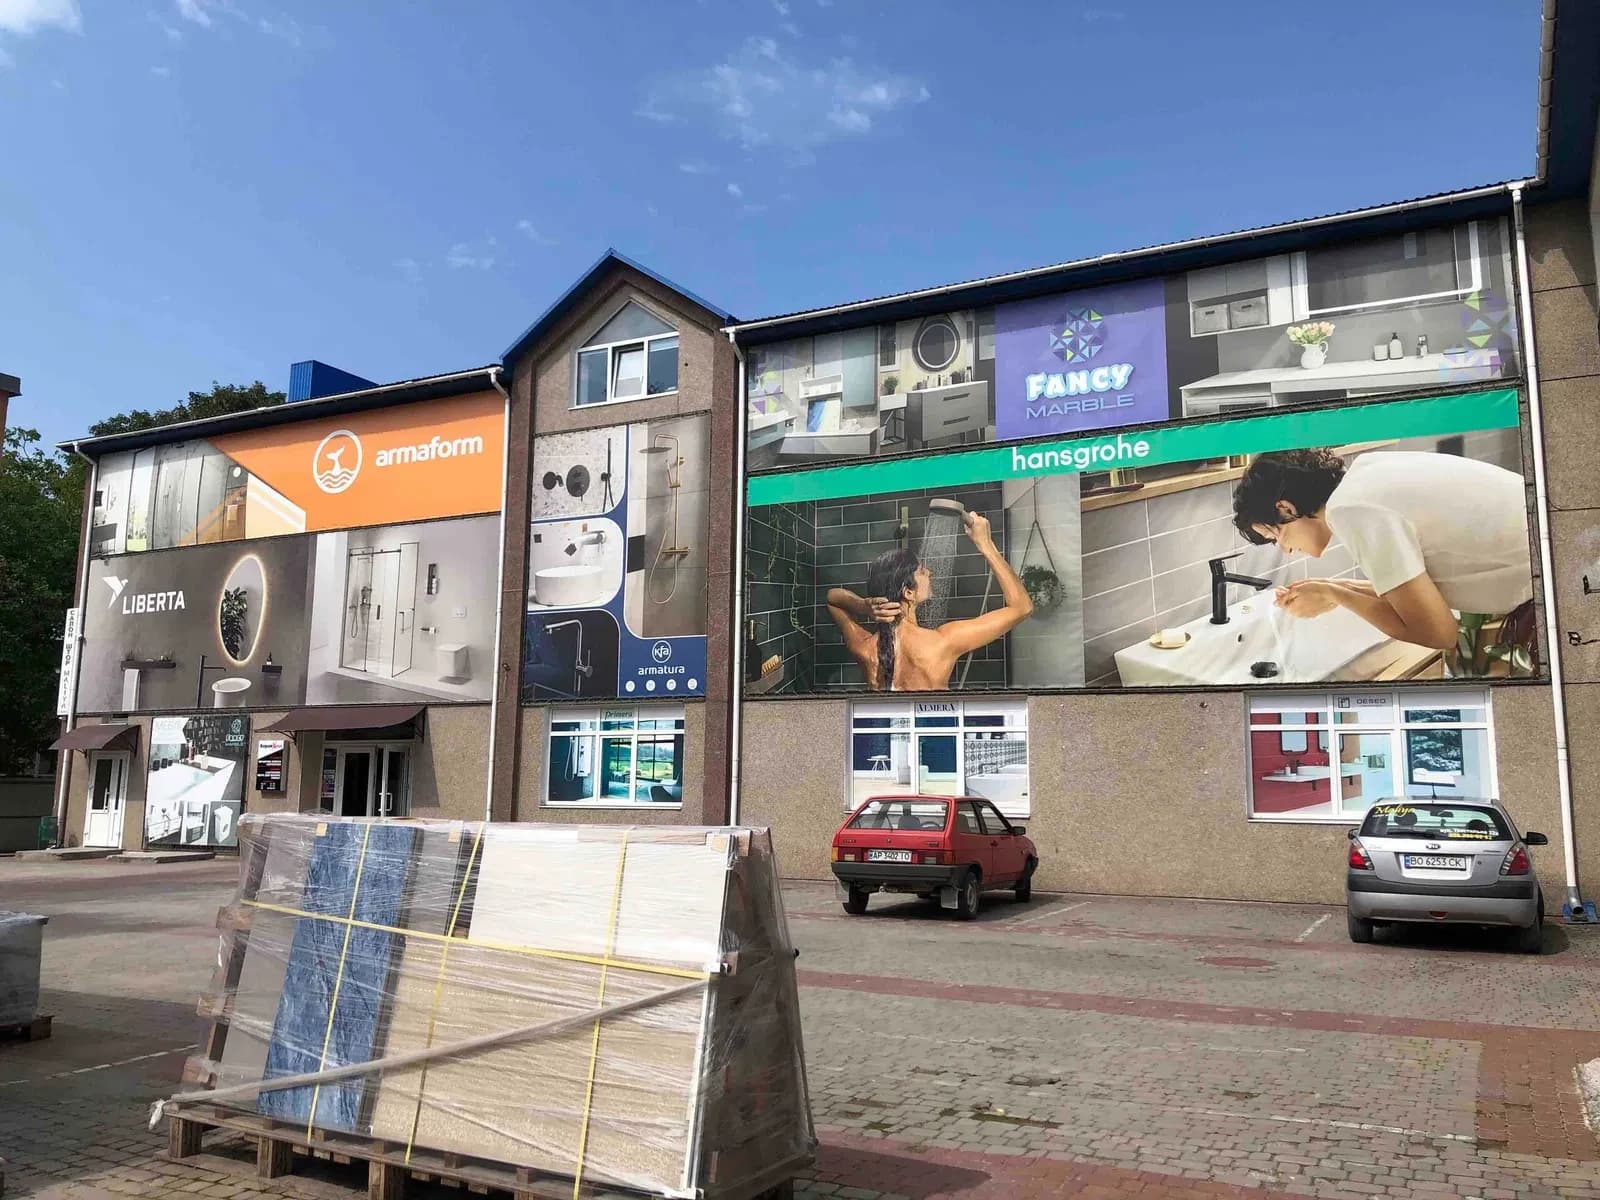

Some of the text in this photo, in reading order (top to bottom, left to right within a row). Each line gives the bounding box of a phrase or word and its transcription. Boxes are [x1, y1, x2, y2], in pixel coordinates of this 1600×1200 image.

[1026, 363, 1134, 401] FANCY
[1026, 393, 1135, 419] MARBLE
[375, 436, 483, 467] armaform
[1011, 434, 1150, 471] hansgrohe
[122, 590, 185, 615] LIBERTA
[637, 665, 686, 676] armatura
[1425, 857, 1447, 867] 6253
[1448, 858, 1463, 868] CK
